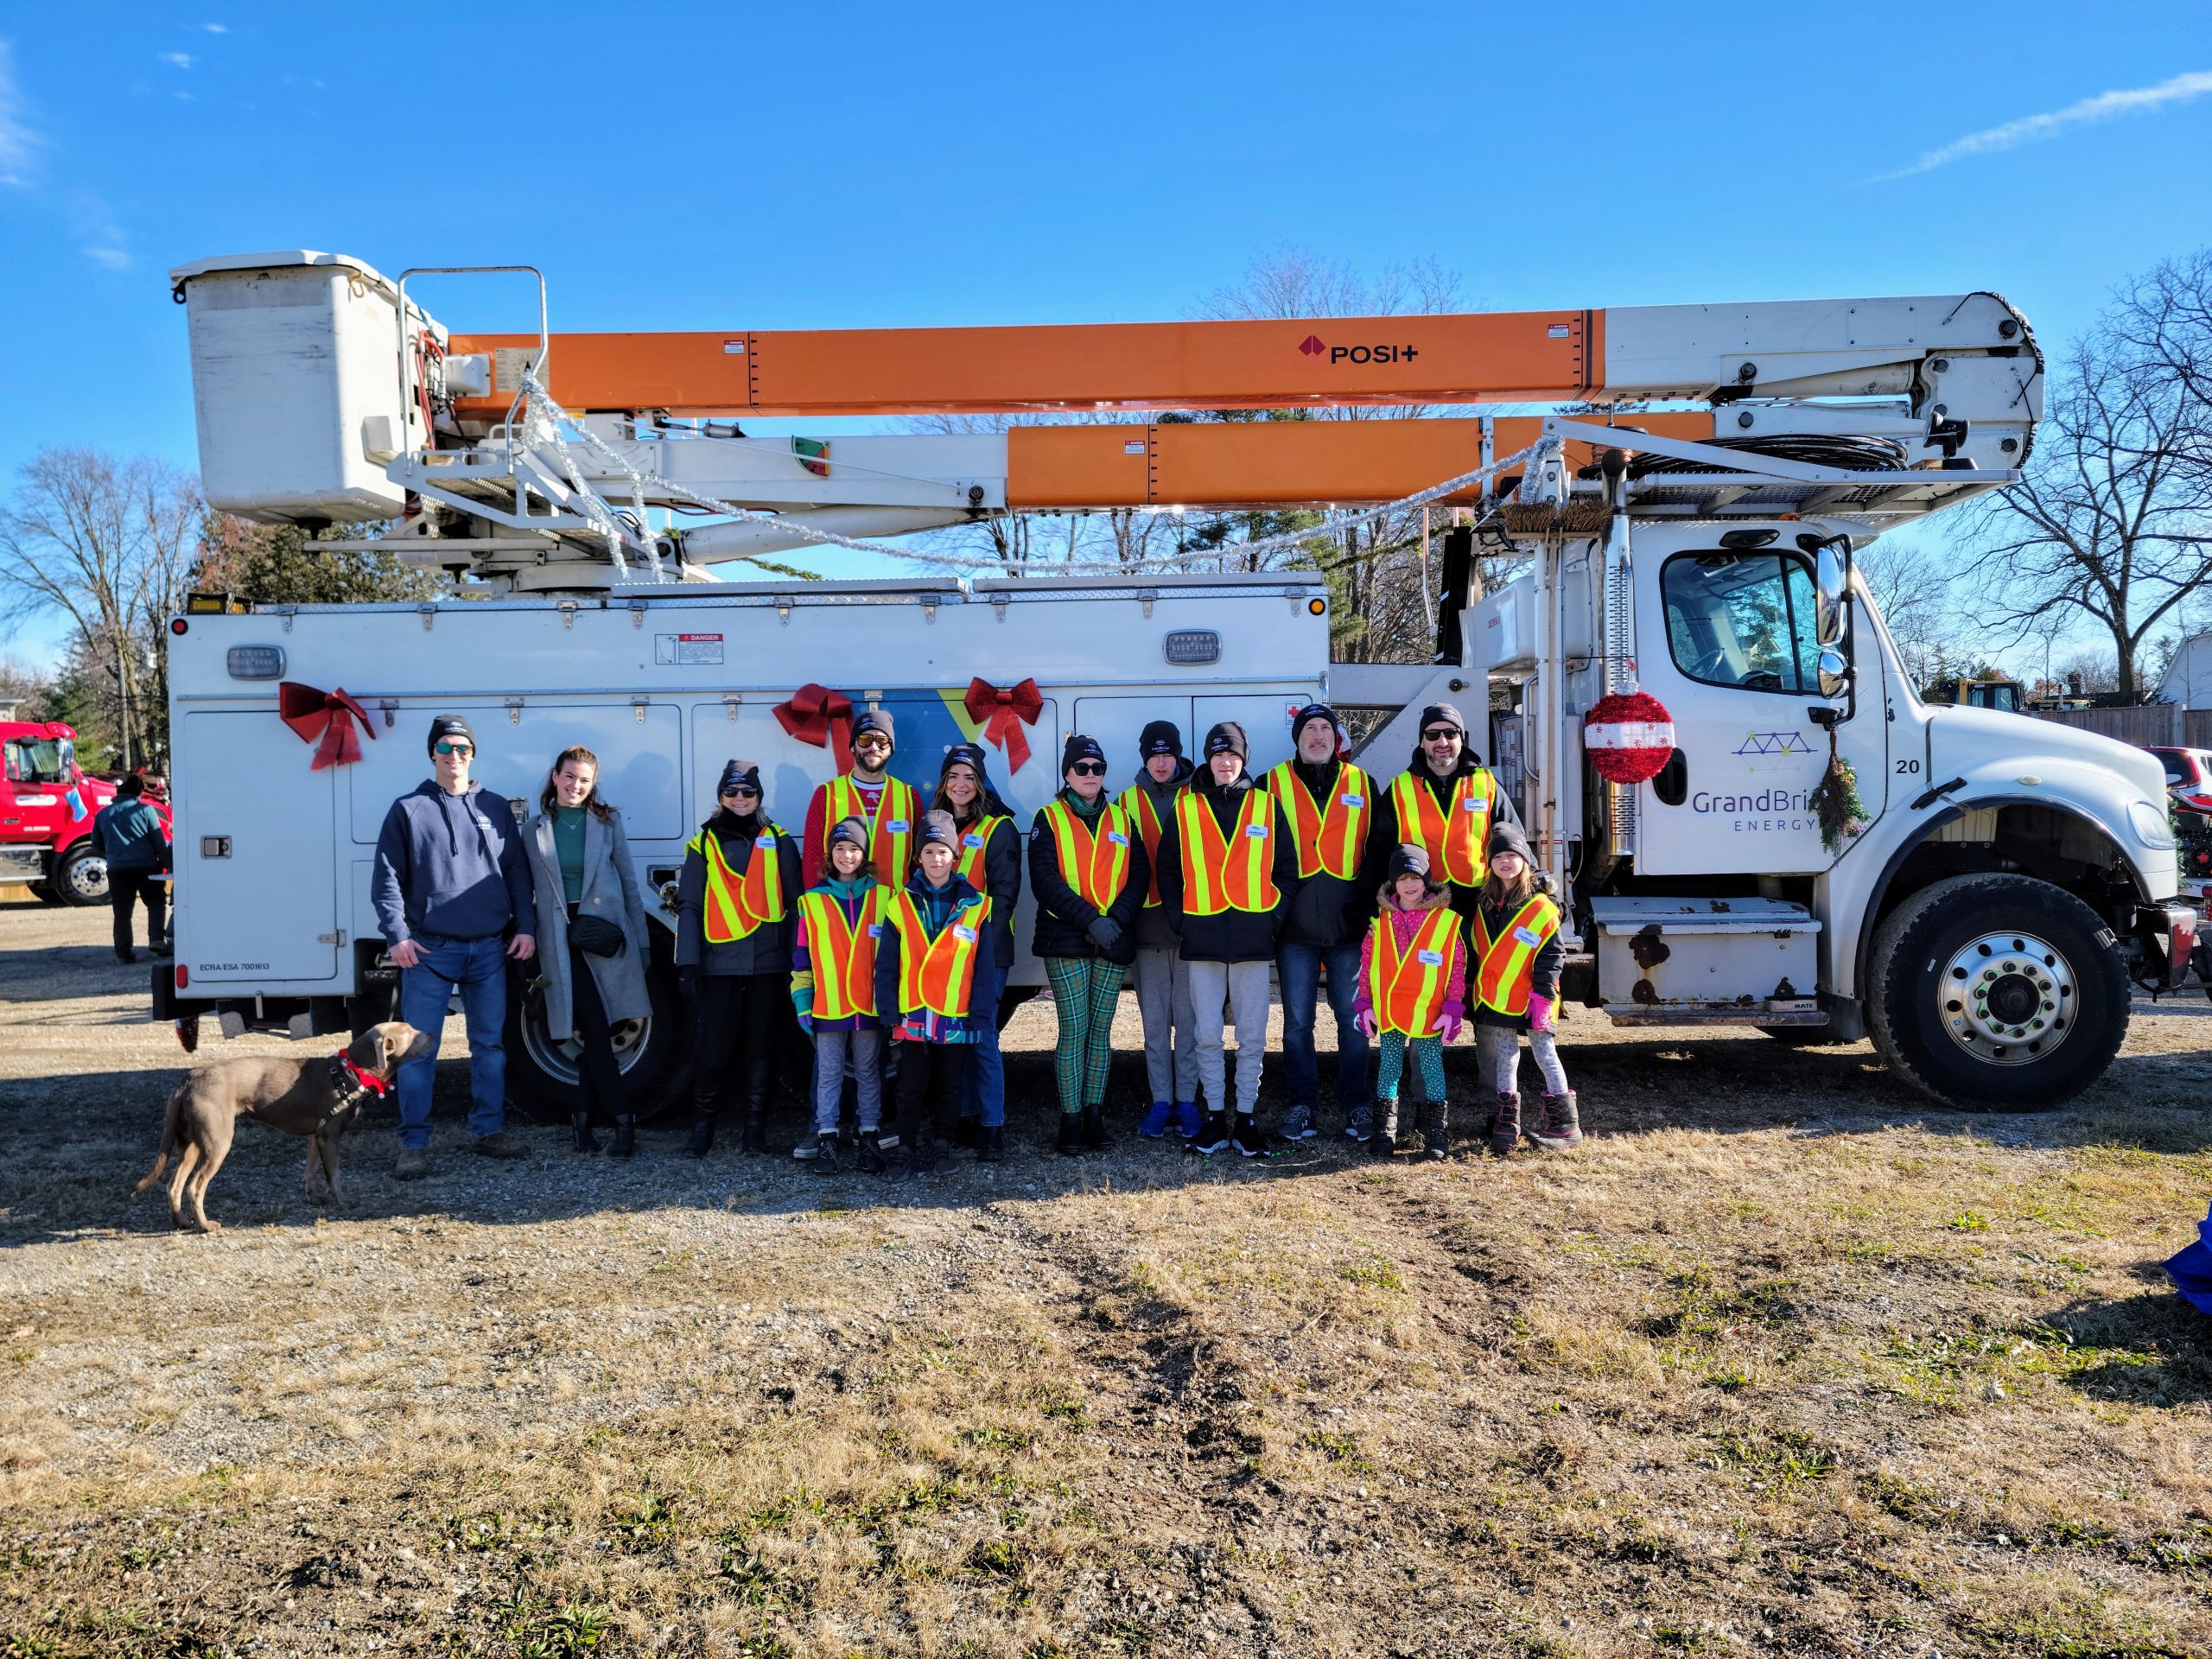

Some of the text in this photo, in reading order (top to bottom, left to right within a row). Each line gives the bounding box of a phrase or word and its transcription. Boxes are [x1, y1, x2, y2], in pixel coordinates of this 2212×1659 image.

[1331, 346, 1419, 365] POSI+
[1896, 760, 1920, 774] 20
[1693, 789, 1817, 813] GrandBri
[1734, 819, 1815, 831] ENERGY
